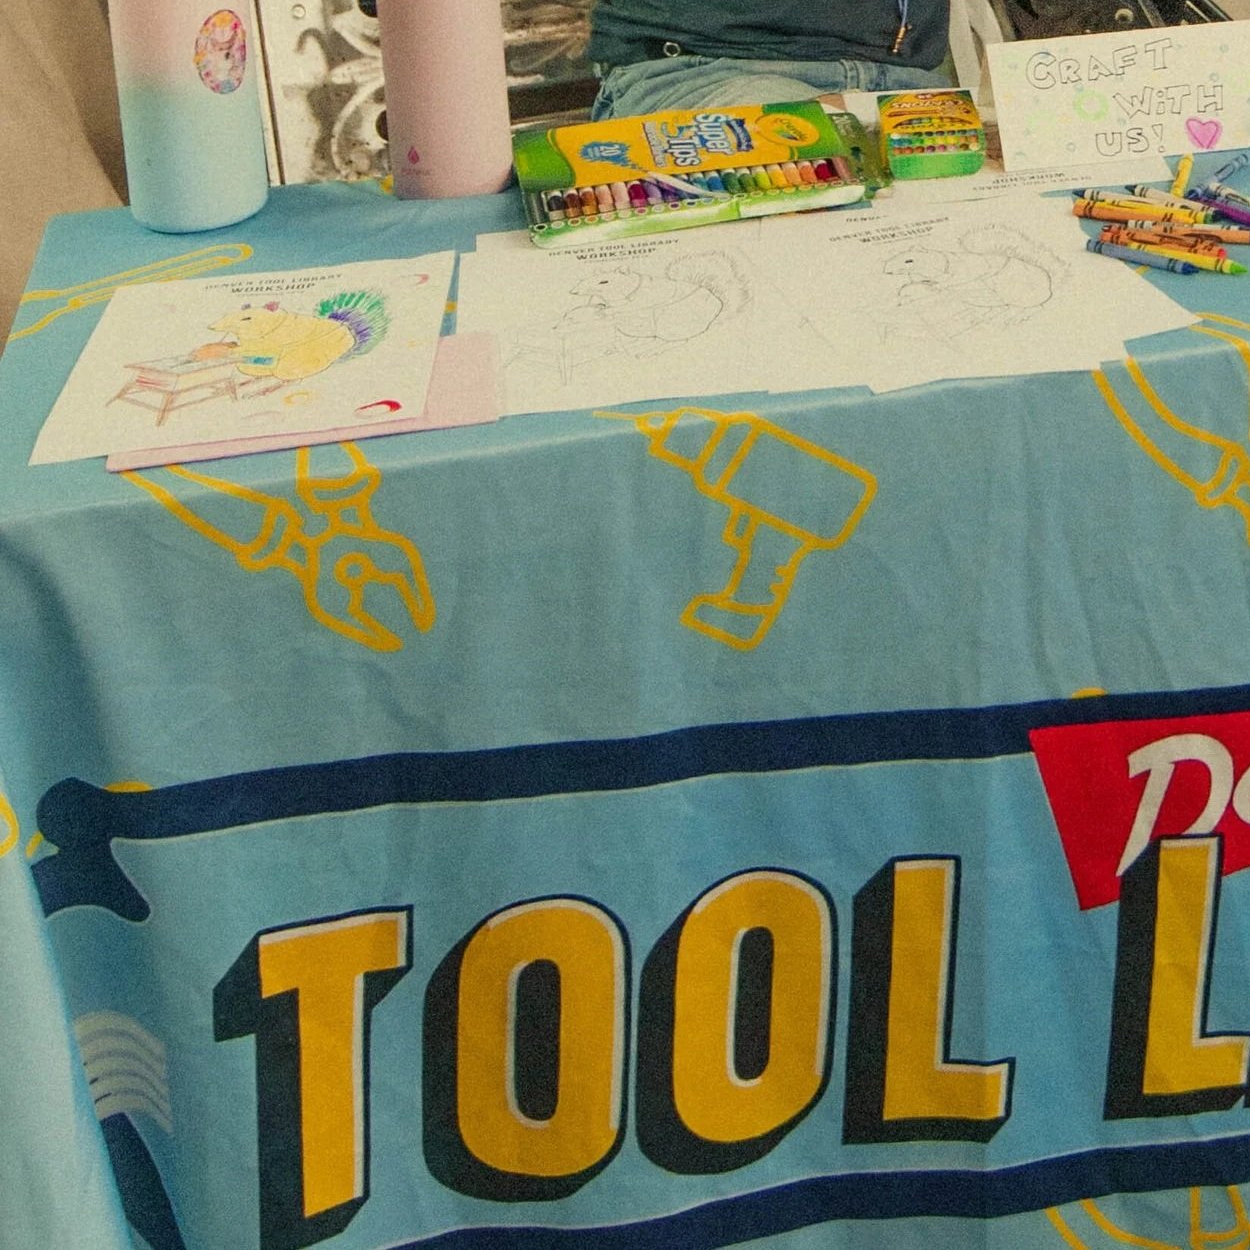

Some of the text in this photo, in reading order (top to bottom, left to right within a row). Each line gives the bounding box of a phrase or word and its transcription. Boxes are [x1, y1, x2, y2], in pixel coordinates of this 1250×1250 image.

[1025, 37, 1173, 90] CRAFT
[696, 113, 736, 155] Super
[1094, 123, 1165, 157] US!
[576, 247, 657, 261] WORKSHOP
[231, 282, 316, 293] WORKSHOP
[214, 854, 1014, 1245] TOOL
